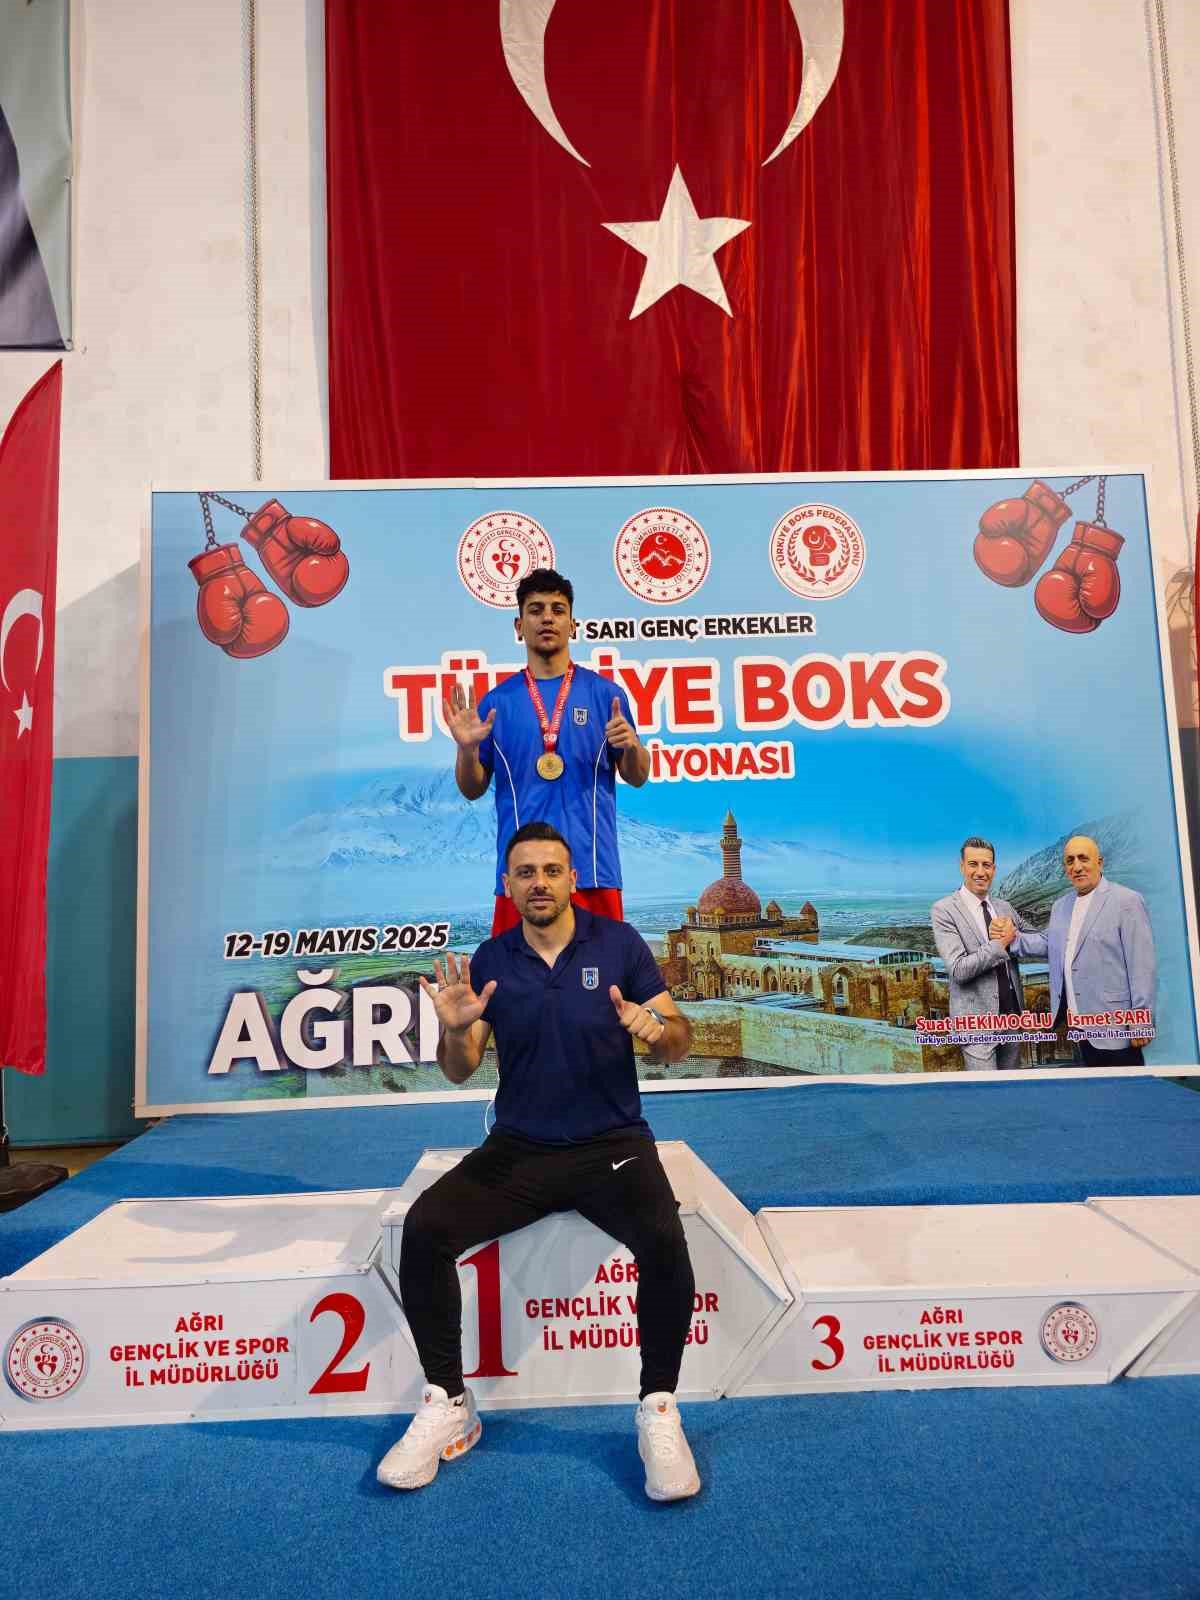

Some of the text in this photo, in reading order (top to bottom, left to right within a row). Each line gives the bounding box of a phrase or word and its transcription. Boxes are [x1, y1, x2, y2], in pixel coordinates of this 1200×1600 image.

[776, 509, 861, 568] TÜRKİYE BOKS FEDERASYONU
[586, 621, 635, 639] SARI
[645, 618, 698, 639] GENÇ
[705, 615, 814, 635] ERKEKLER
[392, 655, 715, 733] TÜYE
[741, 658, 943, 722] BOKS
[652, 743, 790, 778] İYONASI
[226, 925, 448, 957] 12-19 MAYIS 2025
[208, 968, 440, 1074] AĞRI
[916, 1010, 1052, 1031] Suat HEKİMOĞLU
[1068, 1008, 1150, 1025] İsmet SARI
[916, 1036, 945, 1046] Türkiye
[948, 1034, 967, 1043] Boks
[969, 1032, 1022, 1044] Federasyonu
[1087, 1030, 1106, 1039] Boks
[595, 1258, 638, 1283] AĞR
[460, 1240, 518, 1377] 1
[526, 1290, 621, 1320] GENÇLİK
[920, 1306, 963, 1325] AĞRI
[175, 1312, 224, 1333] AĞRI
[110, 1337, 289, 1362] GENÇLİK VE SPOR
[308, 1292, 371, 1395] 2
[544, 1325, 563, 1350] İL
[812, 1315, 844, 1371] 3
[863, 1330, 1023, 1350] GENÇLİK VE SPOR
[125, 1359, 279, 1386] İL MÜDÜRLÜĞÜ
[878, 1350, 1015, 1372] İL MÜDÜRLÜĞÜ
